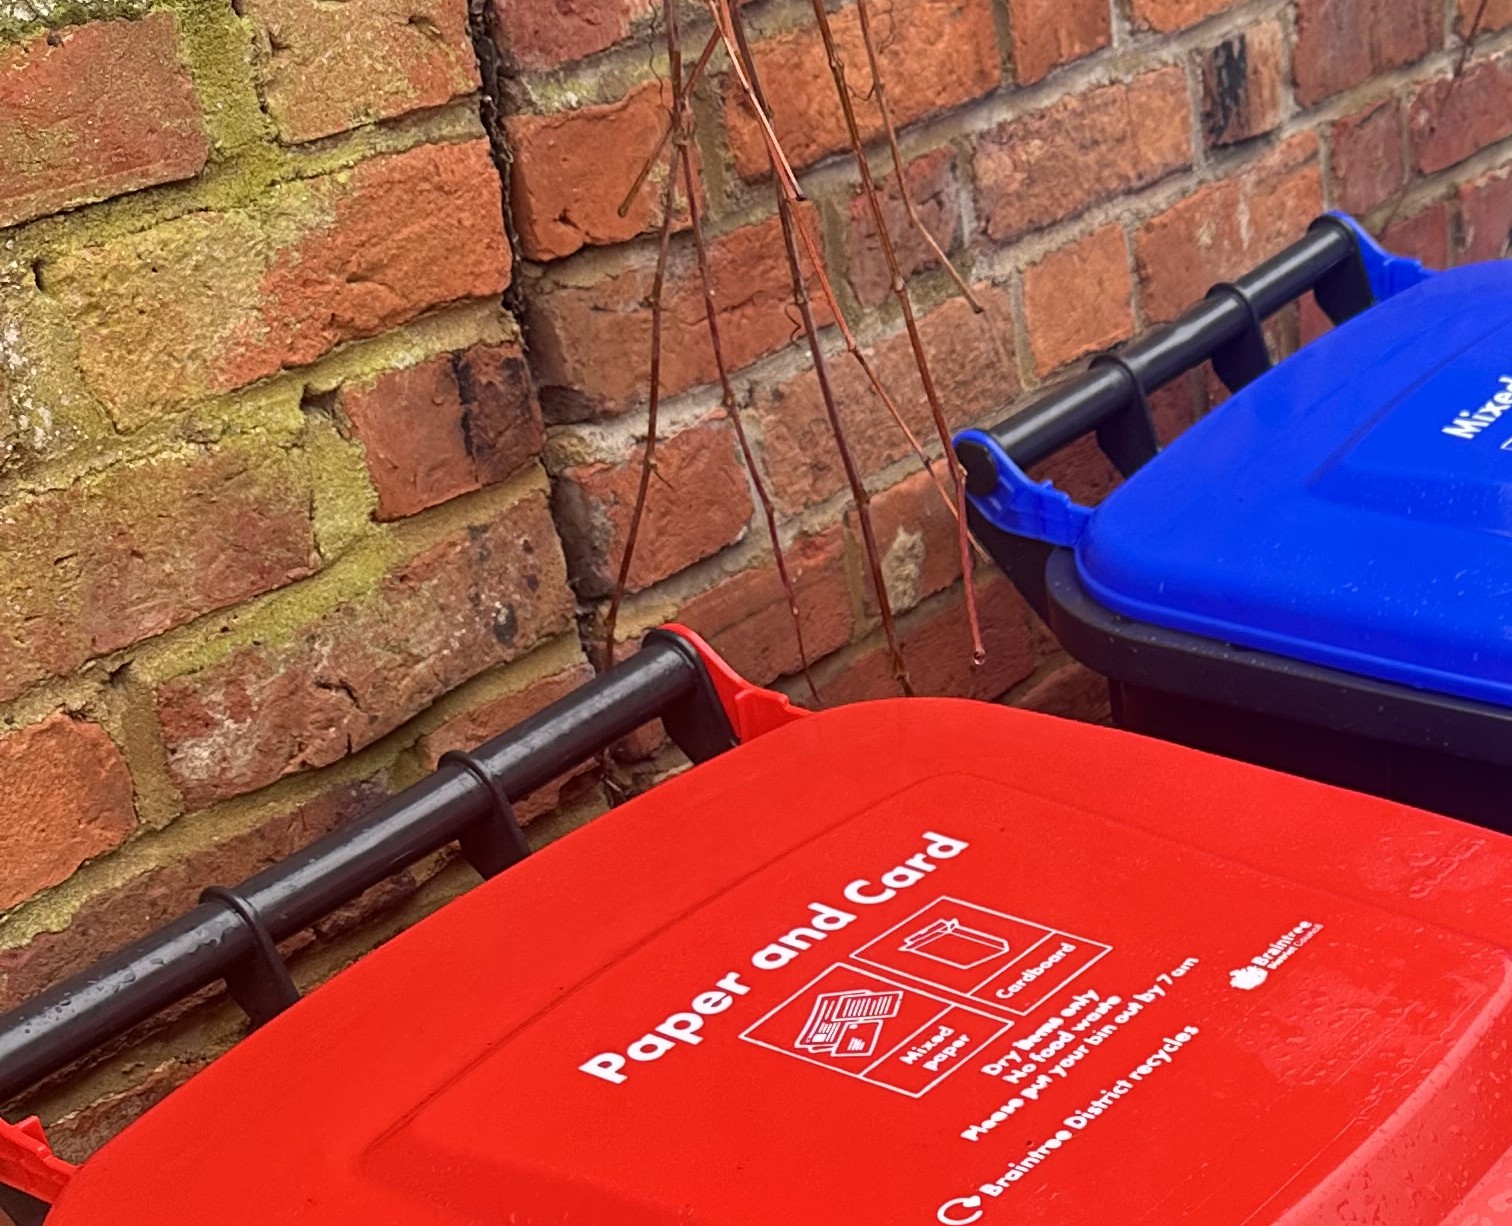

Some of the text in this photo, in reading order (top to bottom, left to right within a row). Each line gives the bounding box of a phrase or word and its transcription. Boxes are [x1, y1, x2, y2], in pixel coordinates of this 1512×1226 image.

[579, 831, 969, 1084] Paper and Card
[996, 942, 1076, 999] Cardboard
[1251, 921, 1313, 967] Braintree
[899, 1025, 955, 1065] Mixed
[923, 1034, 971, 1072] paper
[961, 957, 1199, 1142] Please put your bin out by 7 am
[981, 989, 1100, 1076] Dry items only
[1002, 995, 1122, 1084] No food waste
[979, 1025, 1199, 1197] Braintree District recycles
